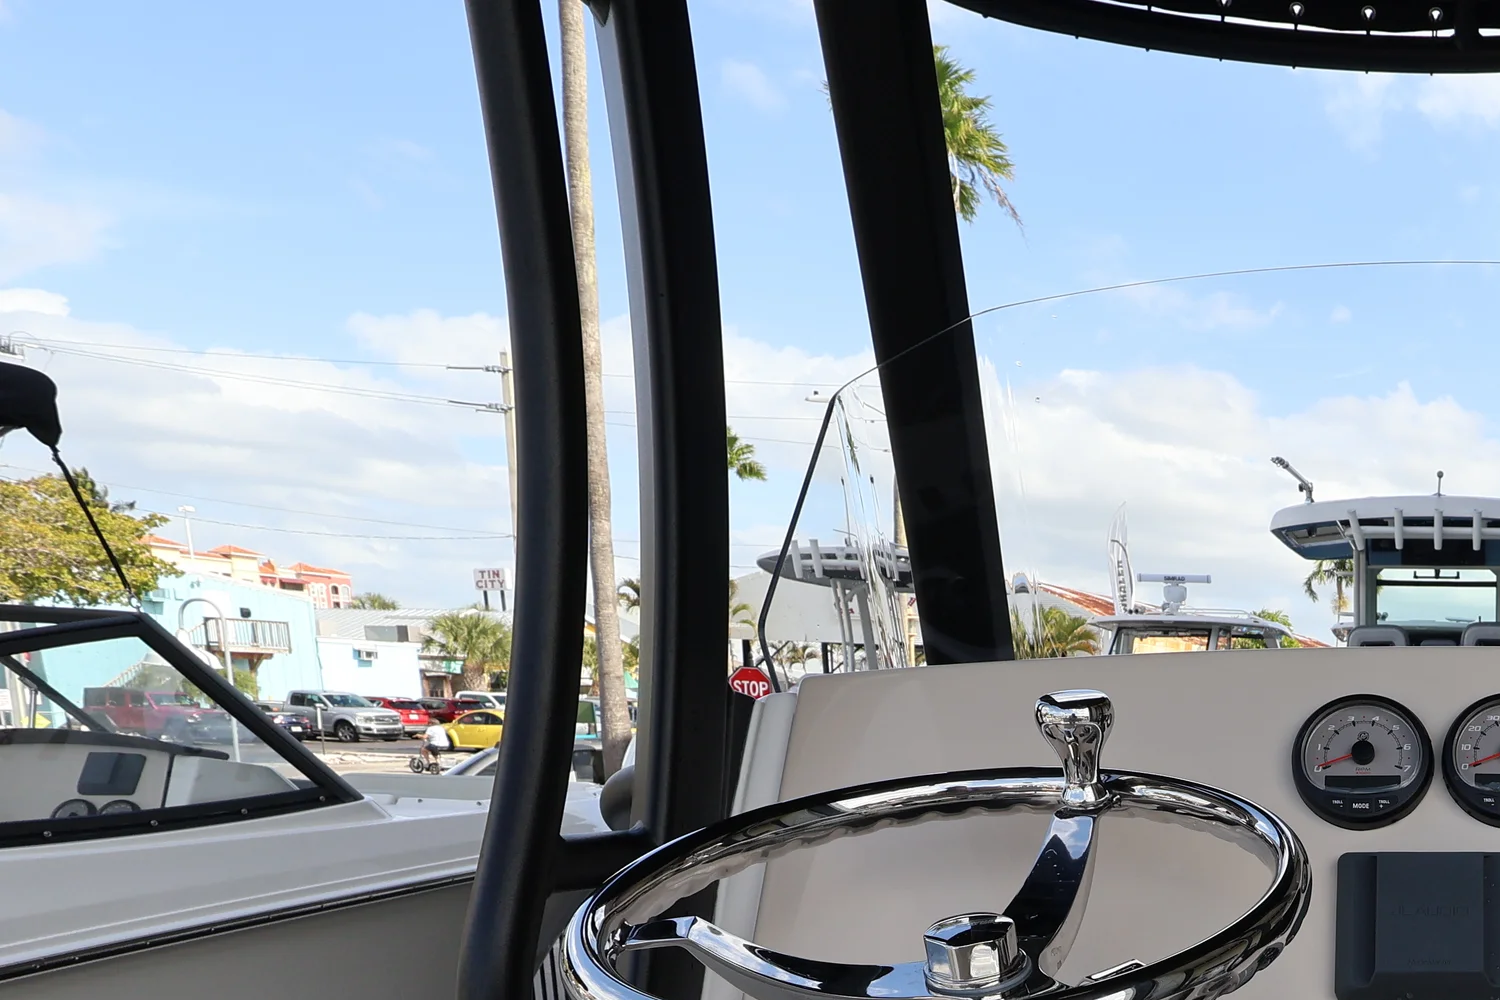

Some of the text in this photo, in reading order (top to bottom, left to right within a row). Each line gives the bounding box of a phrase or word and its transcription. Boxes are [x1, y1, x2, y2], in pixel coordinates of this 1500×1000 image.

[479, 570, 500, 578] TIN
[476, 580, 504, 588] CITY
[734, 680, 768, 696] STOP
